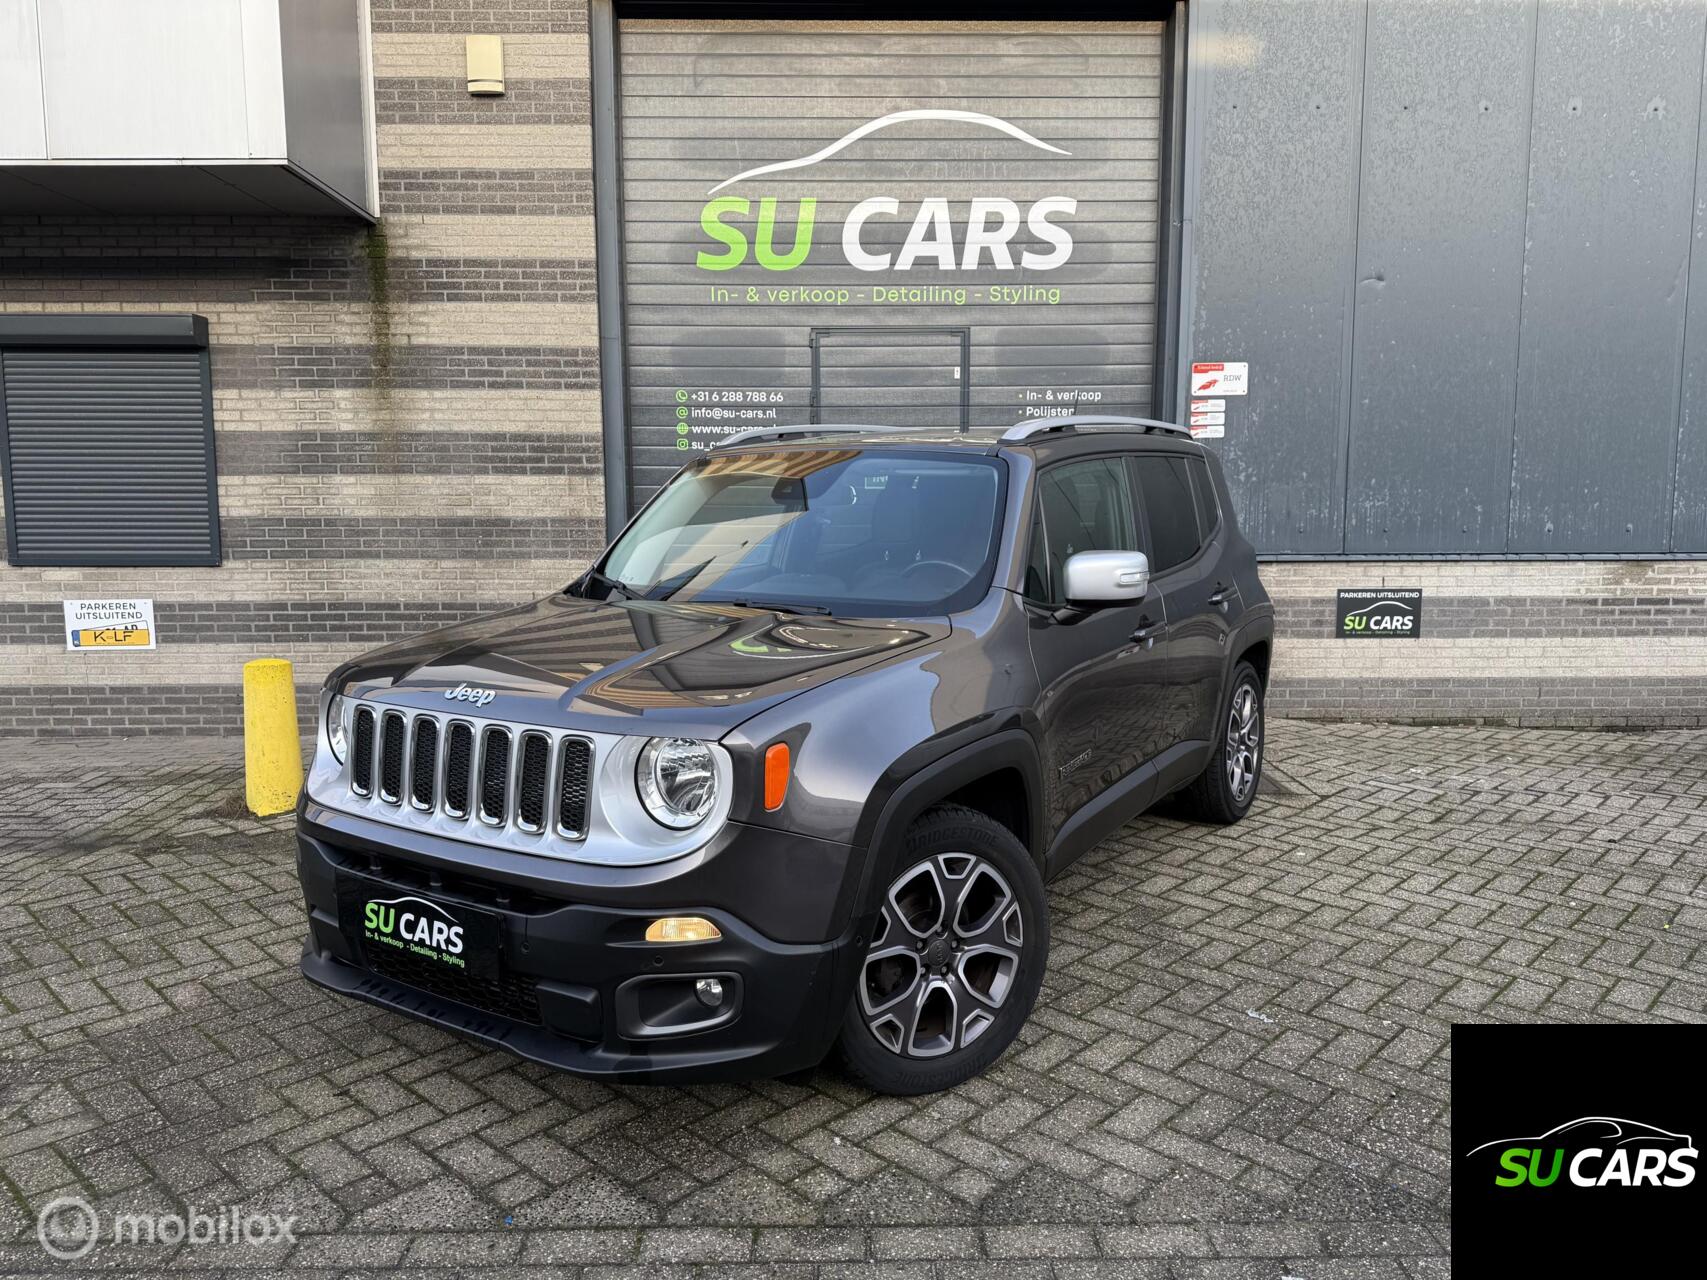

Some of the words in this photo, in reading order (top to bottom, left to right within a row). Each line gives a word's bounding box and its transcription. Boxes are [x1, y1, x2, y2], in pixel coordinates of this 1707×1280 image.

[696, 196, 817, 271] SU
[842, 196, 1078, 271] CARS
[710, 286, 738, 302] In-
[746, 286, 759, 302] &
[768, 285, 849, 305] verkoop
[873, 285, 966, 305] Detailing
[989, 285, 1061, 305] Styling
[1223, 374, 1242, 382] RDW
[691, 391, 709, 401] +31
[712, 391, 719, 401] 6
[722, 391, 743, 402] 288
[746, 391, 767, 402] 788
[770, 391, 784, 402] 66
[1026, 390, 1042, 400] In-
[1045, 390, 1054, 400] &
[691, 407, 776, 419] info@su-cars.nl
[80, 602, 136, 610] PARKEREN
[75, 611, 143, 620] UITSLUITEND
[1343, 615, 1367, 630] SU
[1369, 615, 1414, 630] CARS
[444, 682, 496, 708] Jeep
[364, 902, 395, 934] SU
[399, 912, 464, 954] CARS
[365, 929, 374, 938] In-
[374, 931, 379, 941] &
[379, 934, 404, 950] verkoop
[410, 943, 438, 960] Detailing
[442, 952, 465, 969] Styling
